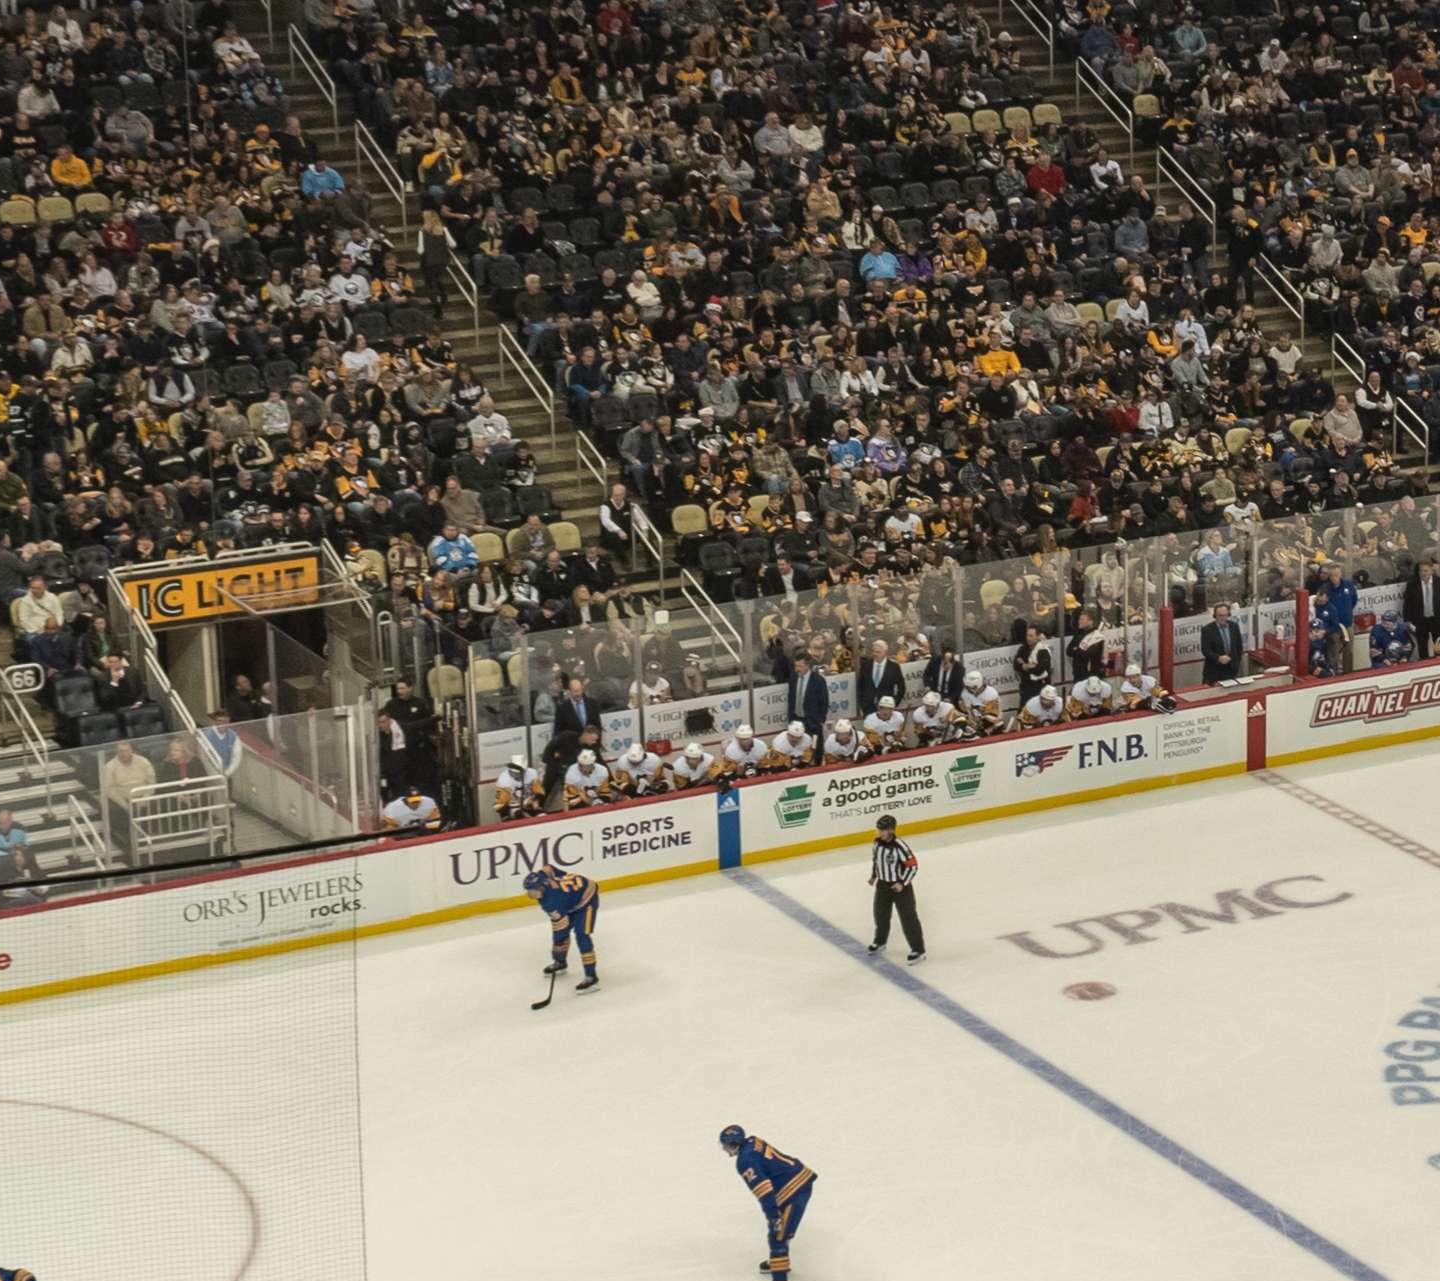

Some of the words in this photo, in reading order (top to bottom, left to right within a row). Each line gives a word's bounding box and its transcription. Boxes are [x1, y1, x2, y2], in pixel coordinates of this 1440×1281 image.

[137, 578, 183, 621] IC
[1078, 733, 1148, 769] F.N.B.
[827, 764, 933, 792] Appreciating
[783, 802, 812, 814] LOTTERY
[822, 796, 832, 808] a
[835, 785, 881, 808] good
[885, 779, 939, 800] game.
[829, 807, 862, 821] THAT'S
[864, 800, 906, 815] LOTTERY
[908, 795, 933, 807] LOVE
[601, 816, 675, 841] SPORTS
[449, 832, 584, 886] UPMC
[601, 831, 692, 859] MEDICINE
[183, 889, 249, 923] ORR'S
[258, 872, 364, 926] JEWELERS
[997, 874, 1354, 959] UPMC
